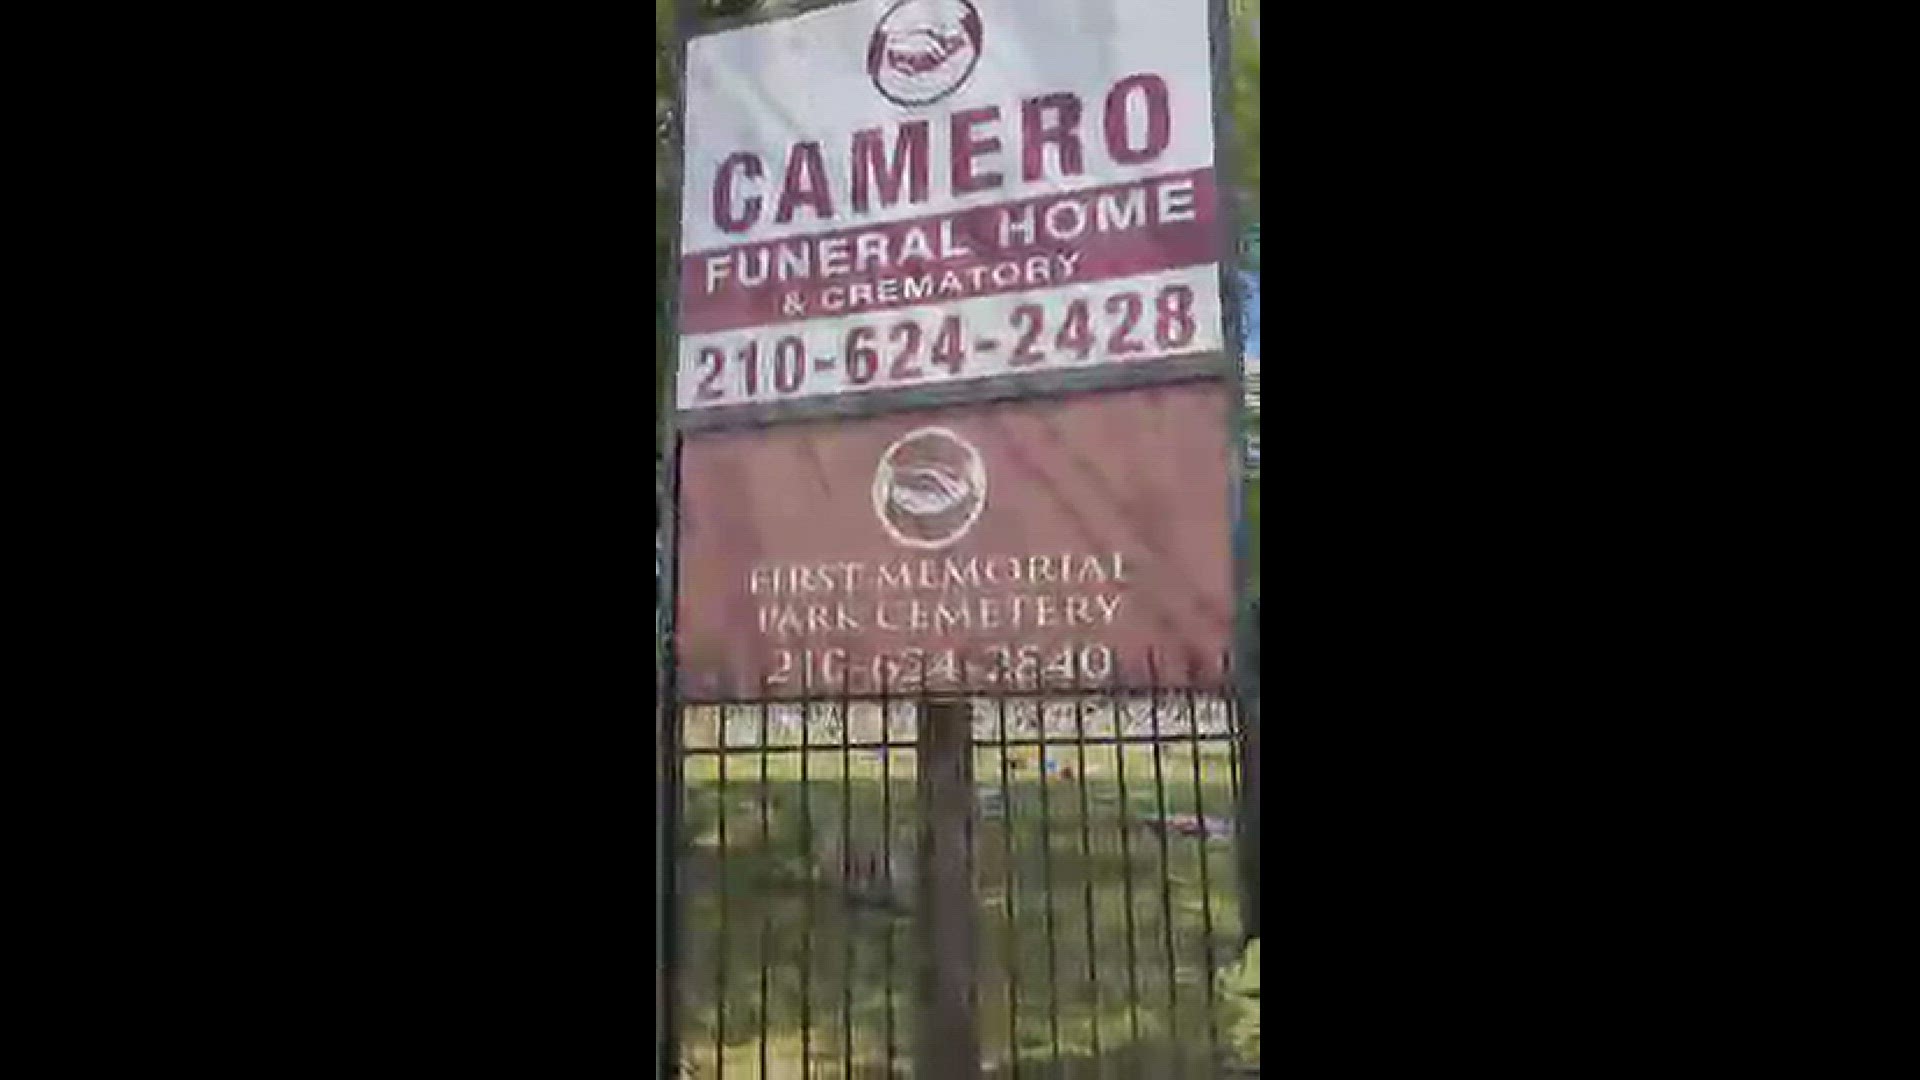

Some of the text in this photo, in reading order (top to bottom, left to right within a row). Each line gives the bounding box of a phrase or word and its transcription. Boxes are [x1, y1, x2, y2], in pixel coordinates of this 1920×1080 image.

[712, 72, 1171, 234] CAMERO
[705, 180, 1196, 292] FUNERAL HOME
[782, 252, 1080, 316] & CREMATORY
[697, 285, 1197, 402] 210-624-2428
[749, 552, 1130, 596] FIRST MEMORIAL
[758, 593, 1122, 635] PARK CEMETERY
